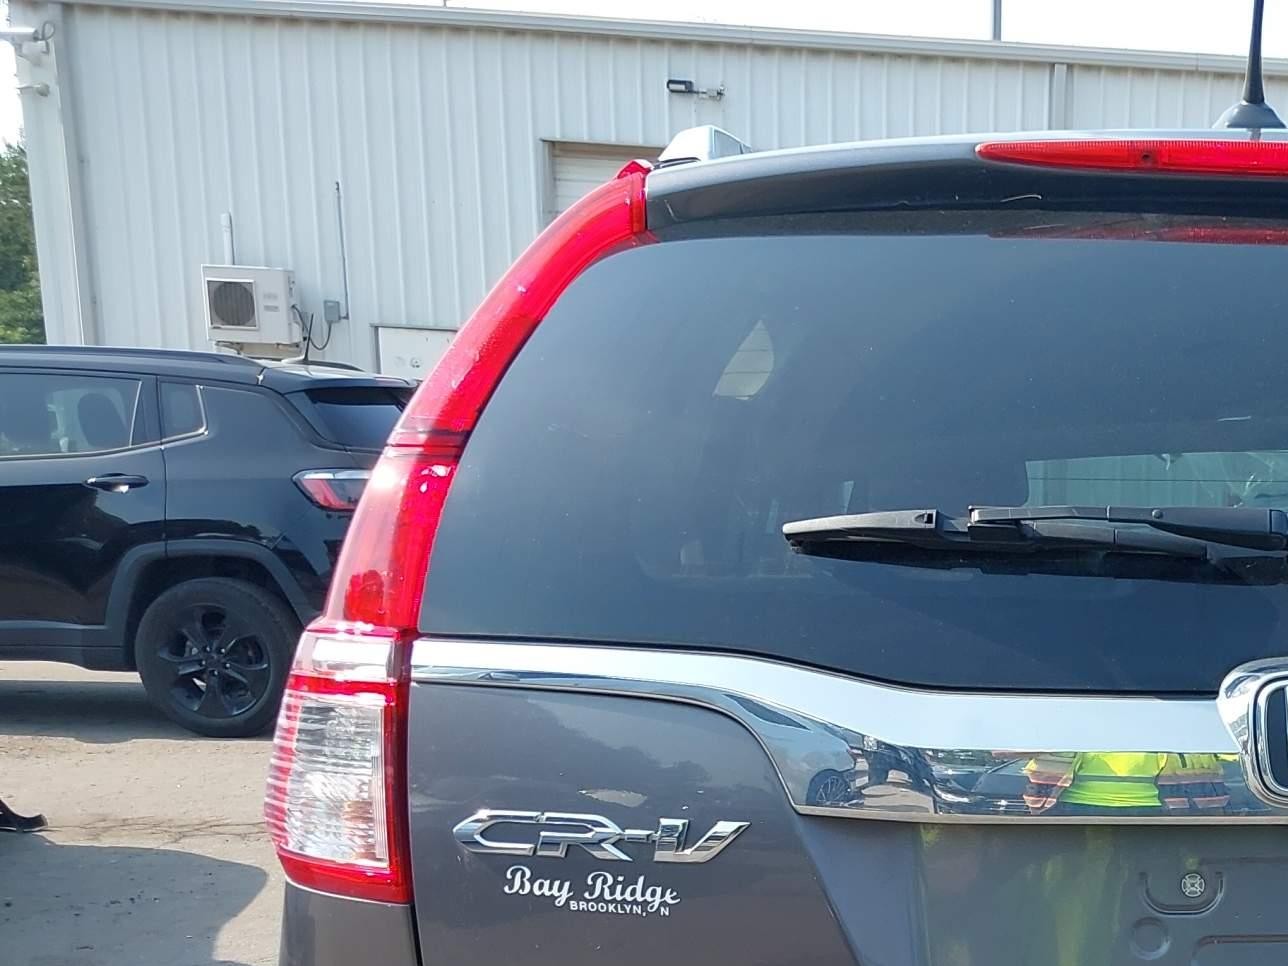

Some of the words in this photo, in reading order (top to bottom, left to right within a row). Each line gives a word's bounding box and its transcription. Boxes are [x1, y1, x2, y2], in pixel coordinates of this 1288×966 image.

[452, 808, 751, 864] CR-V
[503, 865, 574, 907] Bay
[584, 871, 681, 913] Ridge
[569, 900, 647, 917] BROOKLYN,
